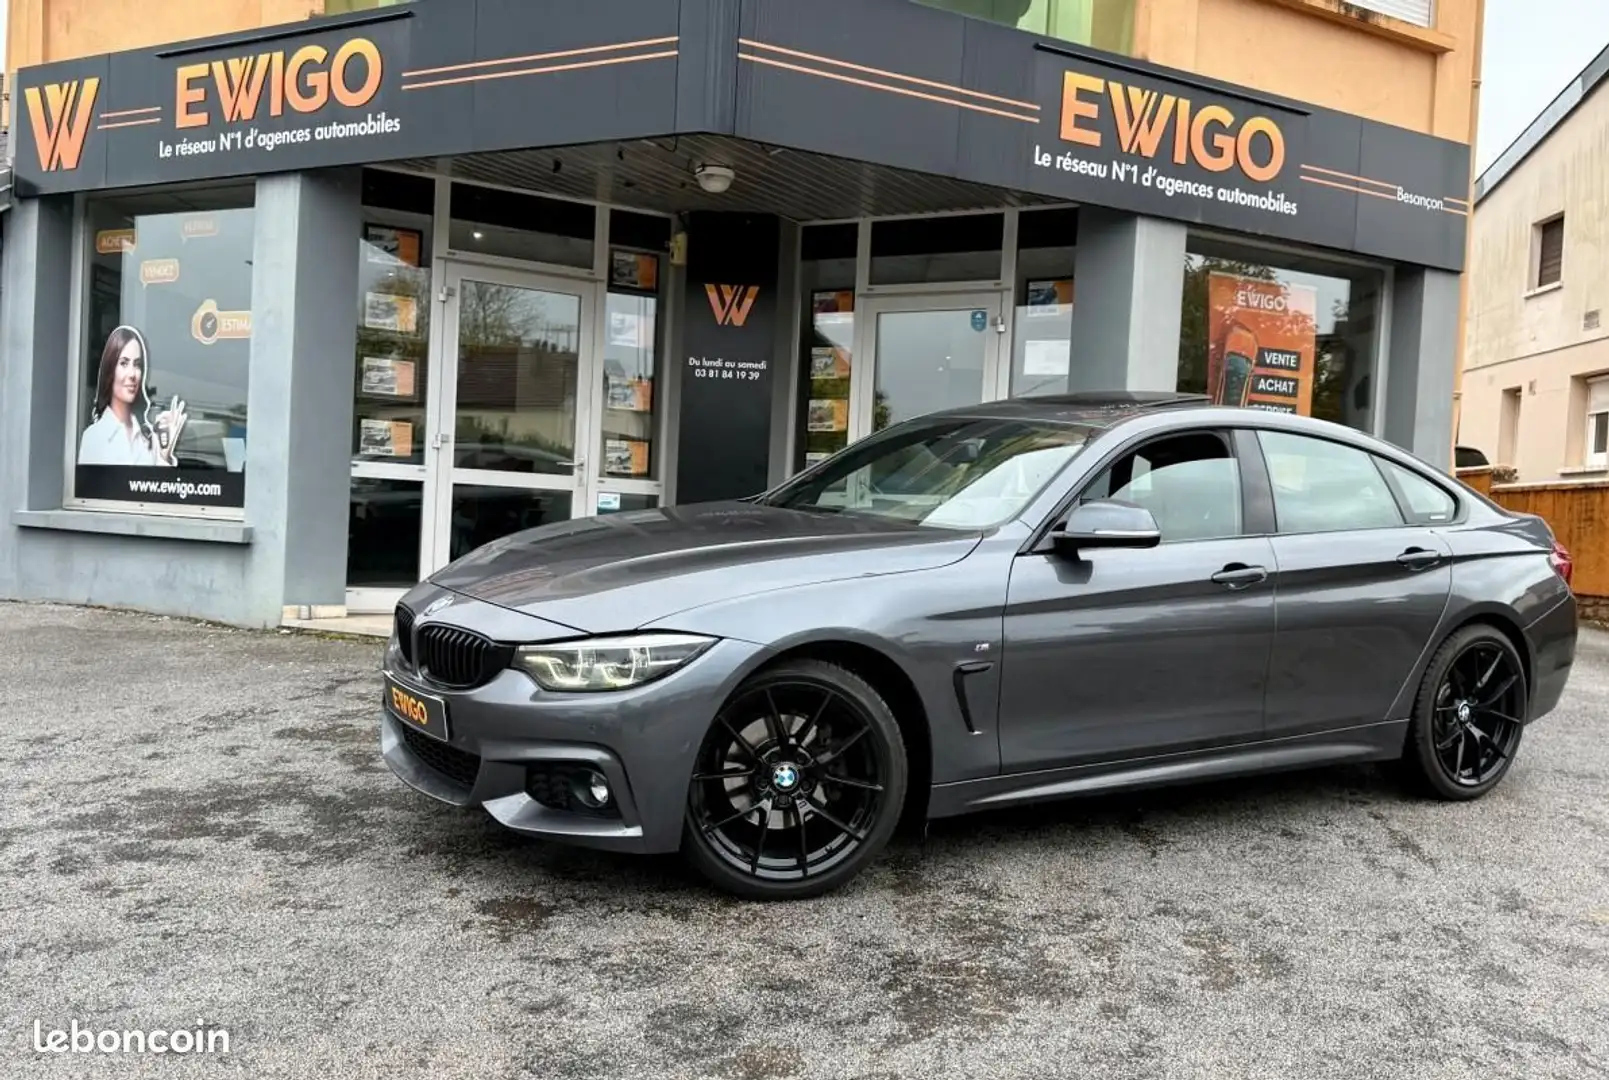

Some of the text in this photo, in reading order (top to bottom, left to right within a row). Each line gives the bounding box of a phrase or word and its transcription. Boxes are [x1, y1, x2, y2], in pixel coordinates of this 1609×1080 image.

[175, 37, 383, 130] EWIGO
[159, 140, 173, 159] Le
[175, 136, 216, 157] réseau
[315, 111, 401, 140] automobiles
[1059, 70, 1285, 182] EWIGO
[1034, 145, 1052, 168] Le
[1056, 150, 1108, 179] réseau
[1217, 187, 1298, 216] automobiles
[1396, 186, 1444, 211] Besançon
[1237, 292, 1285, 311] EWIGO
[688, 357, 700, 366] Du
[702, 357, 723, 367] lundi
[738, 360, 767, 369] samedi
[1264, 351, 1297, 367] VENTE
[695, 369, 760, 380] 03 81 84 19 39
[1258, 377, 1295, 393] ACHAT
[129, 478, 222, 499] www.ewigo.com
[392, 687, 428, 725] EWIGO
